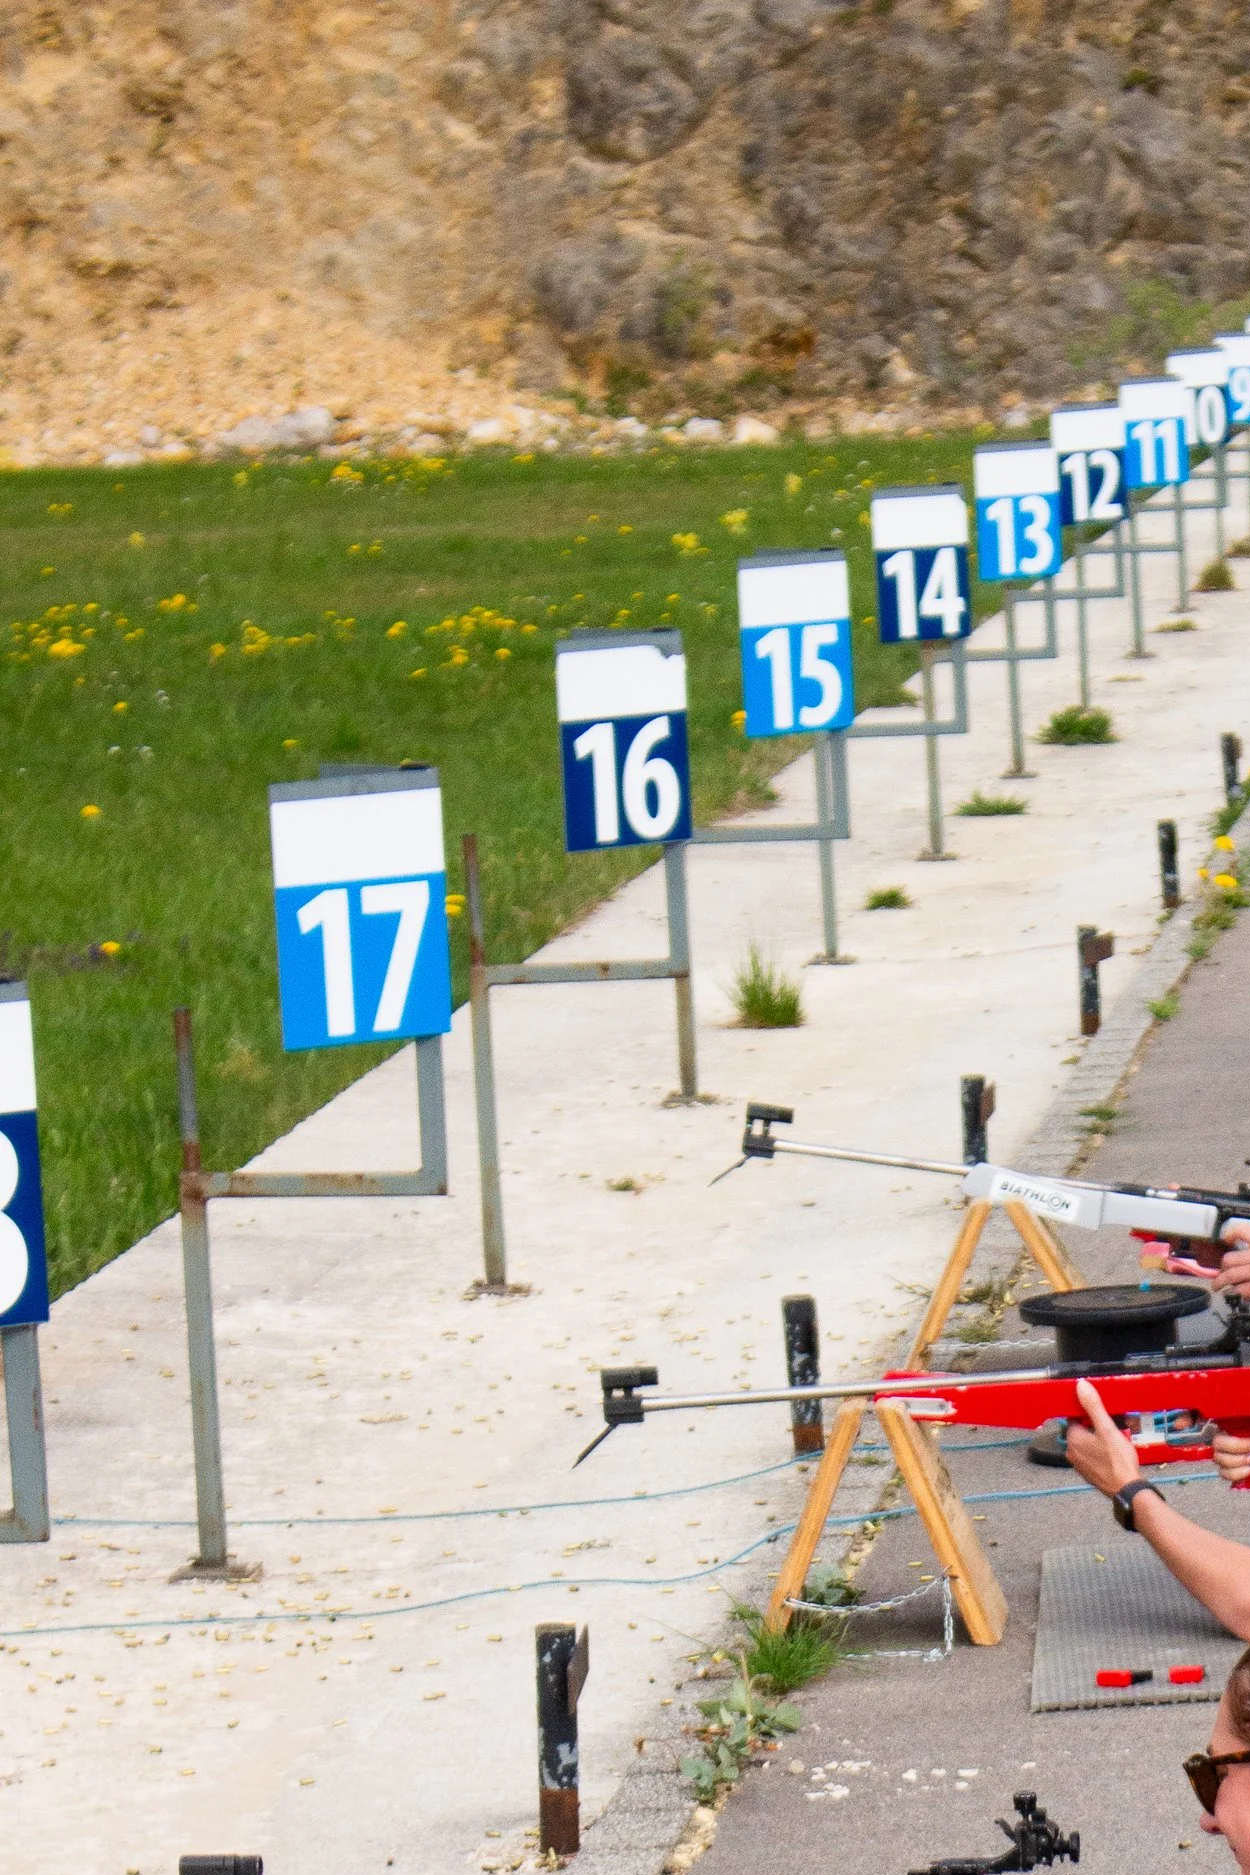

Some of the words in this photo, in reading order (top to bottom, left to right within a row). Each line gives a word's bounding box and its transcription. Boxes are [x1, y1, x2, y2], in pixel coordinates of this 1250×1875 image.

[1131, 419, 1180, 483] 11
[1186, 386, 1227, 443] 10
[1061, 449, 1123, 521] 12
[985, 494, 1054, 575] 13
[882, 546, 966, 639] 14
[755, 623, 843, 730] 15
[573, 715, 681, 843] 16
[297, 880, 430, 1037] 17
